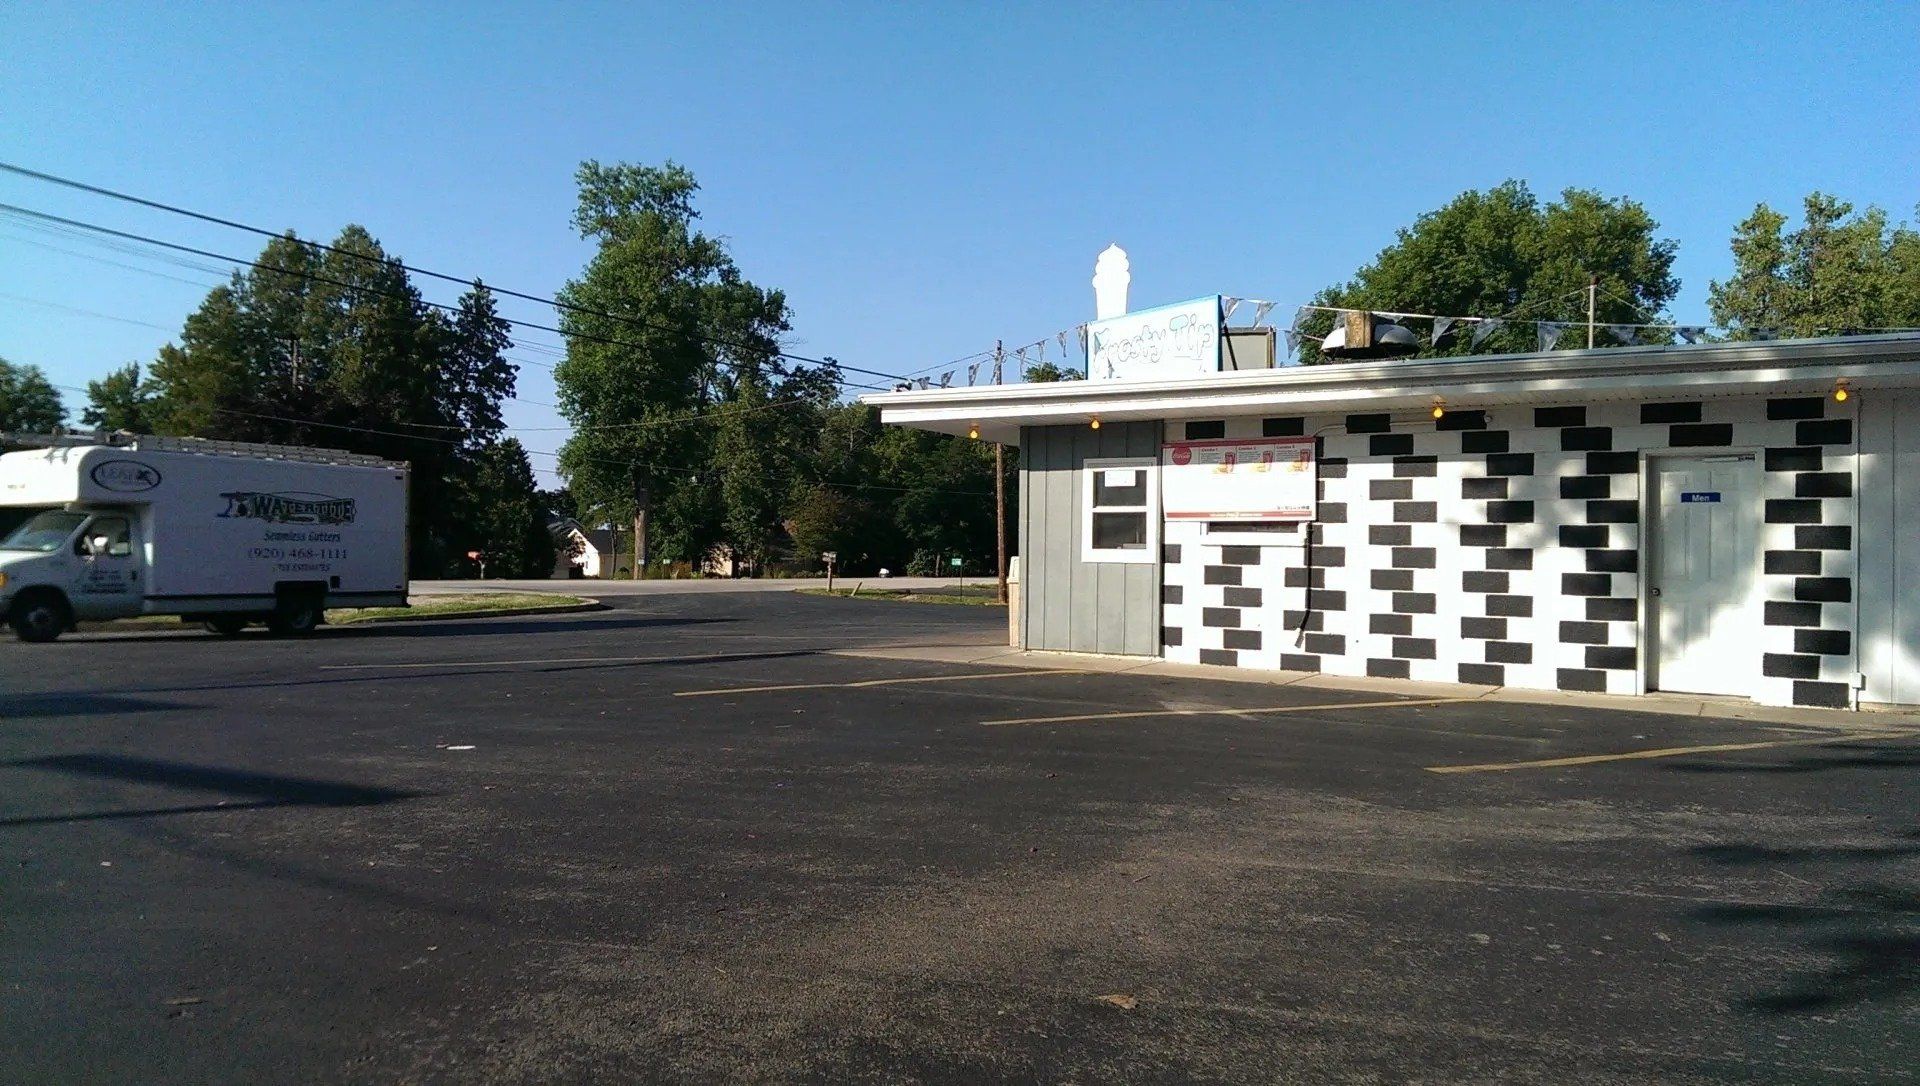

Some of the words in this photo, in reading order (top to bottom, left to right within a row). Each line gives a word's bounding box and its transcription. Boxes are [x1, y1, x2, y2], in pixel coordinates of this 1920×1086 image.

[1093, 327, 1167, 373] Frosty
[1168, 313, 1215, 359] Tip
[1691, 494, 1710, 502] Men
[308, 531, 341, 543] Gutters
[247, 547, 285, 559] (920)
